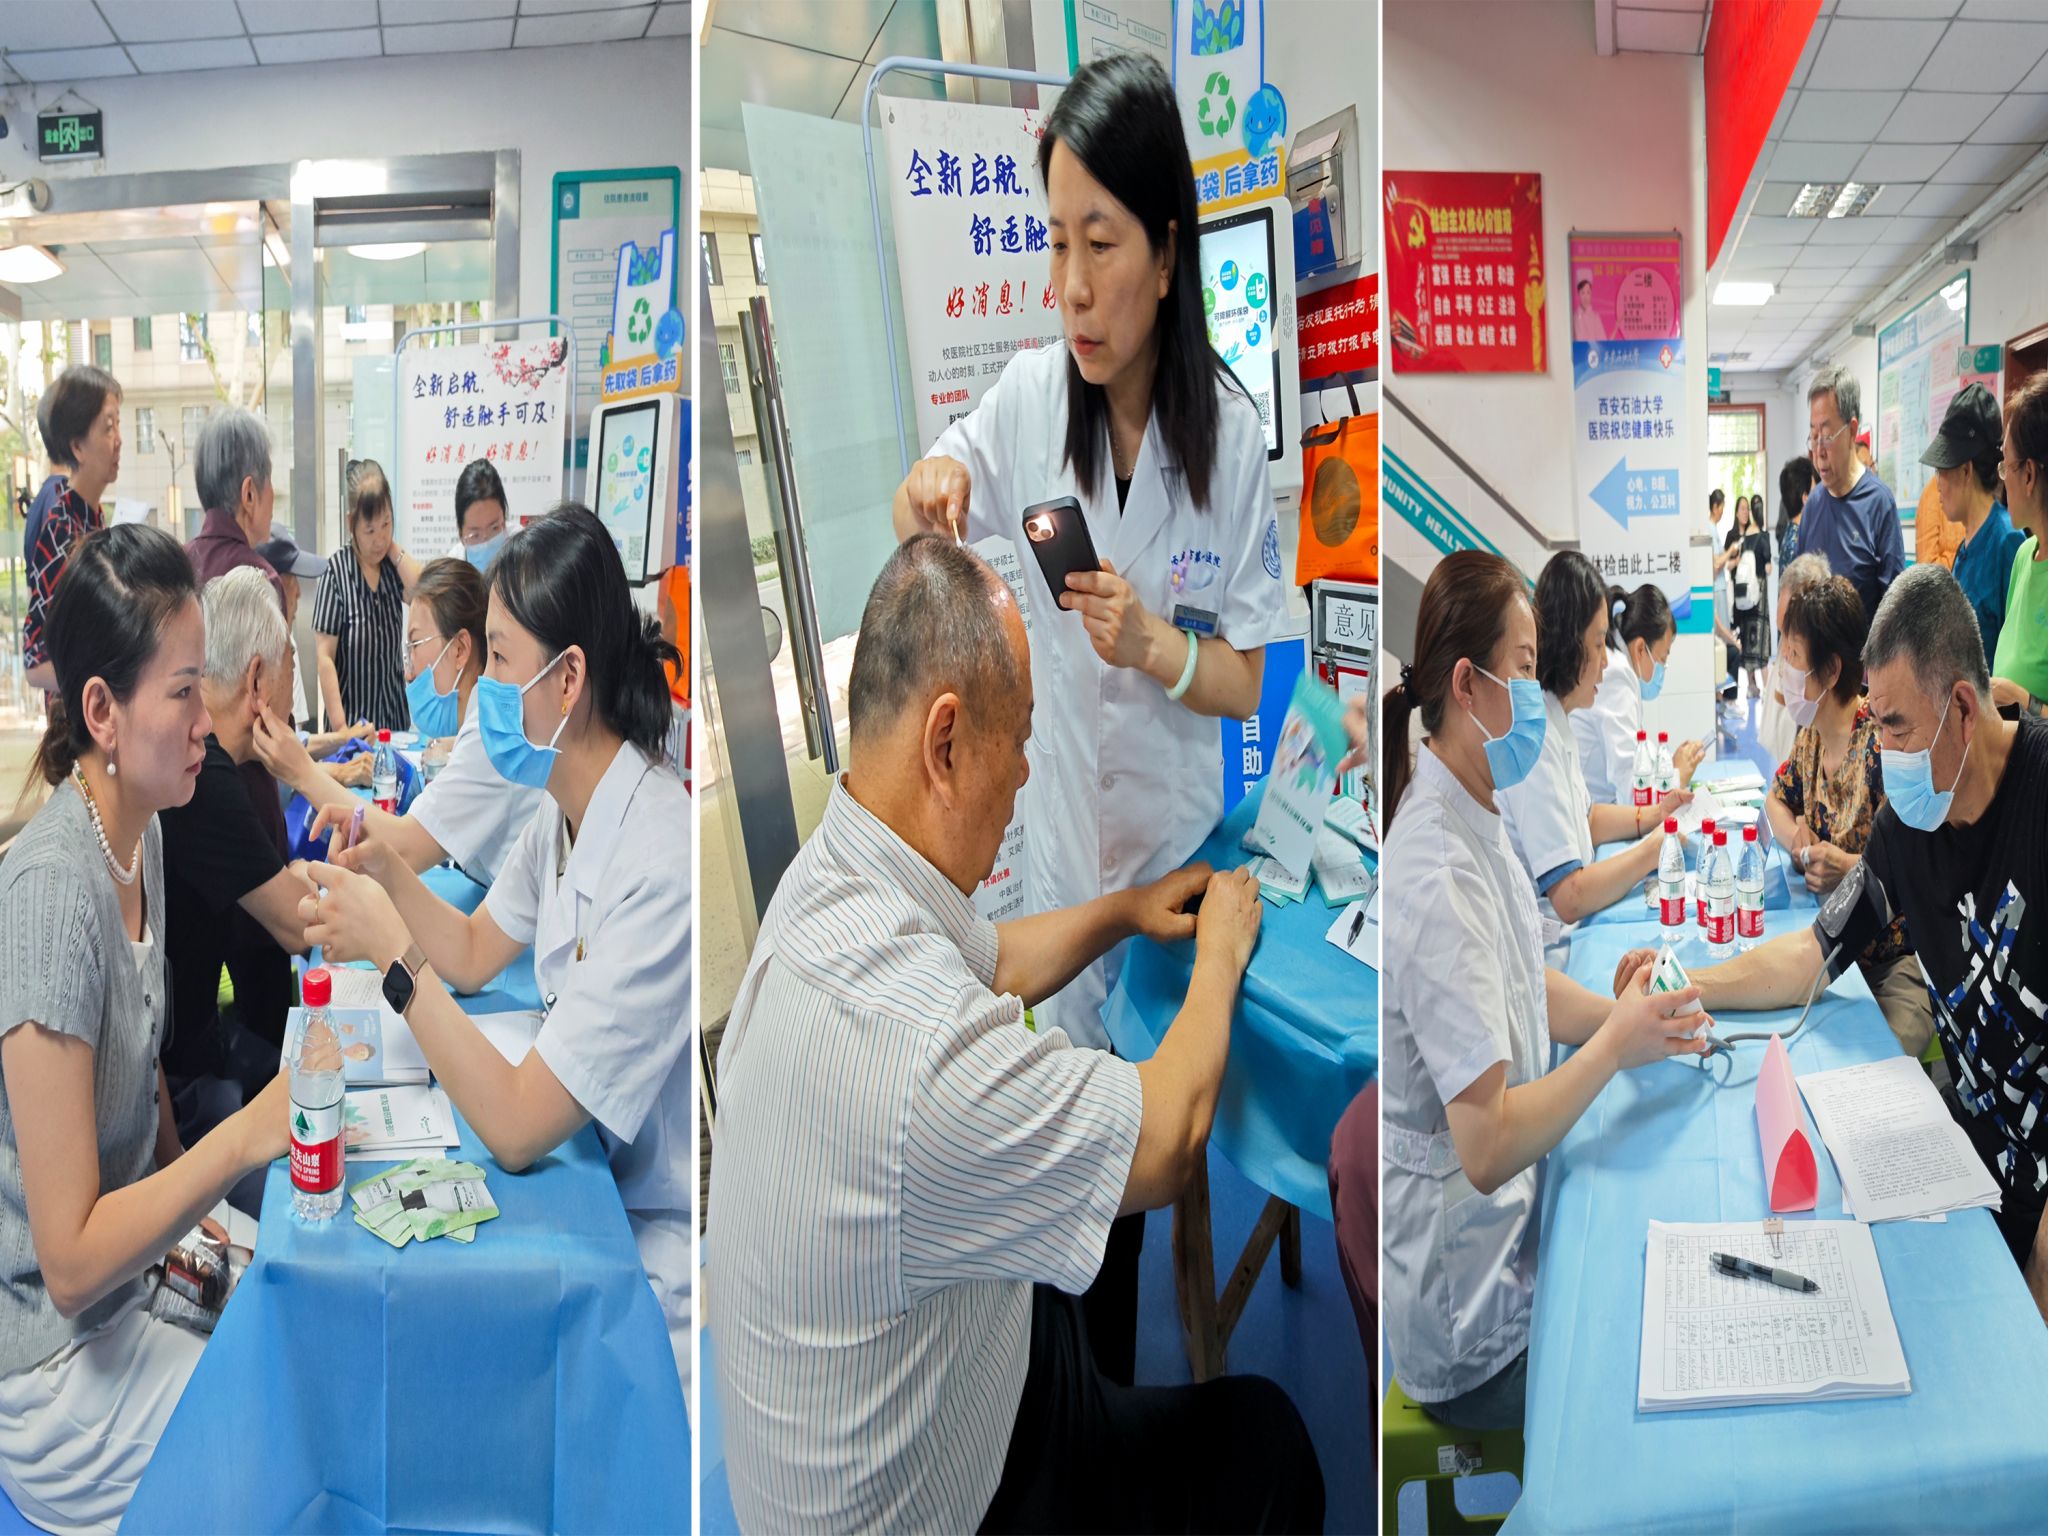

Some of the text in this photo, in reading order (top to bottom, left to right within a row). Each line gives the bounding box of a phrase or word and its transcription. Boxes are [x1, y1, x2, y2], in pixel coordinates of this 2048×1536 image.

[1224, 155, 1279, 197] 后拿药
[1430, 207, 1513, 235] 社会主义核心价值观
[969, 213, 1051, 256] 舒适触
[1453, 264, 1472, 287] 民主
[1475, 264, 1494, 287] 文明
[1634, 272, 1653, 289] 二楼
[1434, 294, 1516, 317] 自由 平等 公正 法治
[1435, 324, 1453, 347] 爱国
[1478, 324, 1496, 347] 诚信
[604, 358, 676, 393] 先取袋 后拿药
[931, 388, 970, 406] 专业的团队
[1598, 395, 1664, 416] 西安石油大学
[1588, 419, 1675, 441] 医院祝您健康快乐
[1425, 514, 1467, 552] HEALT
